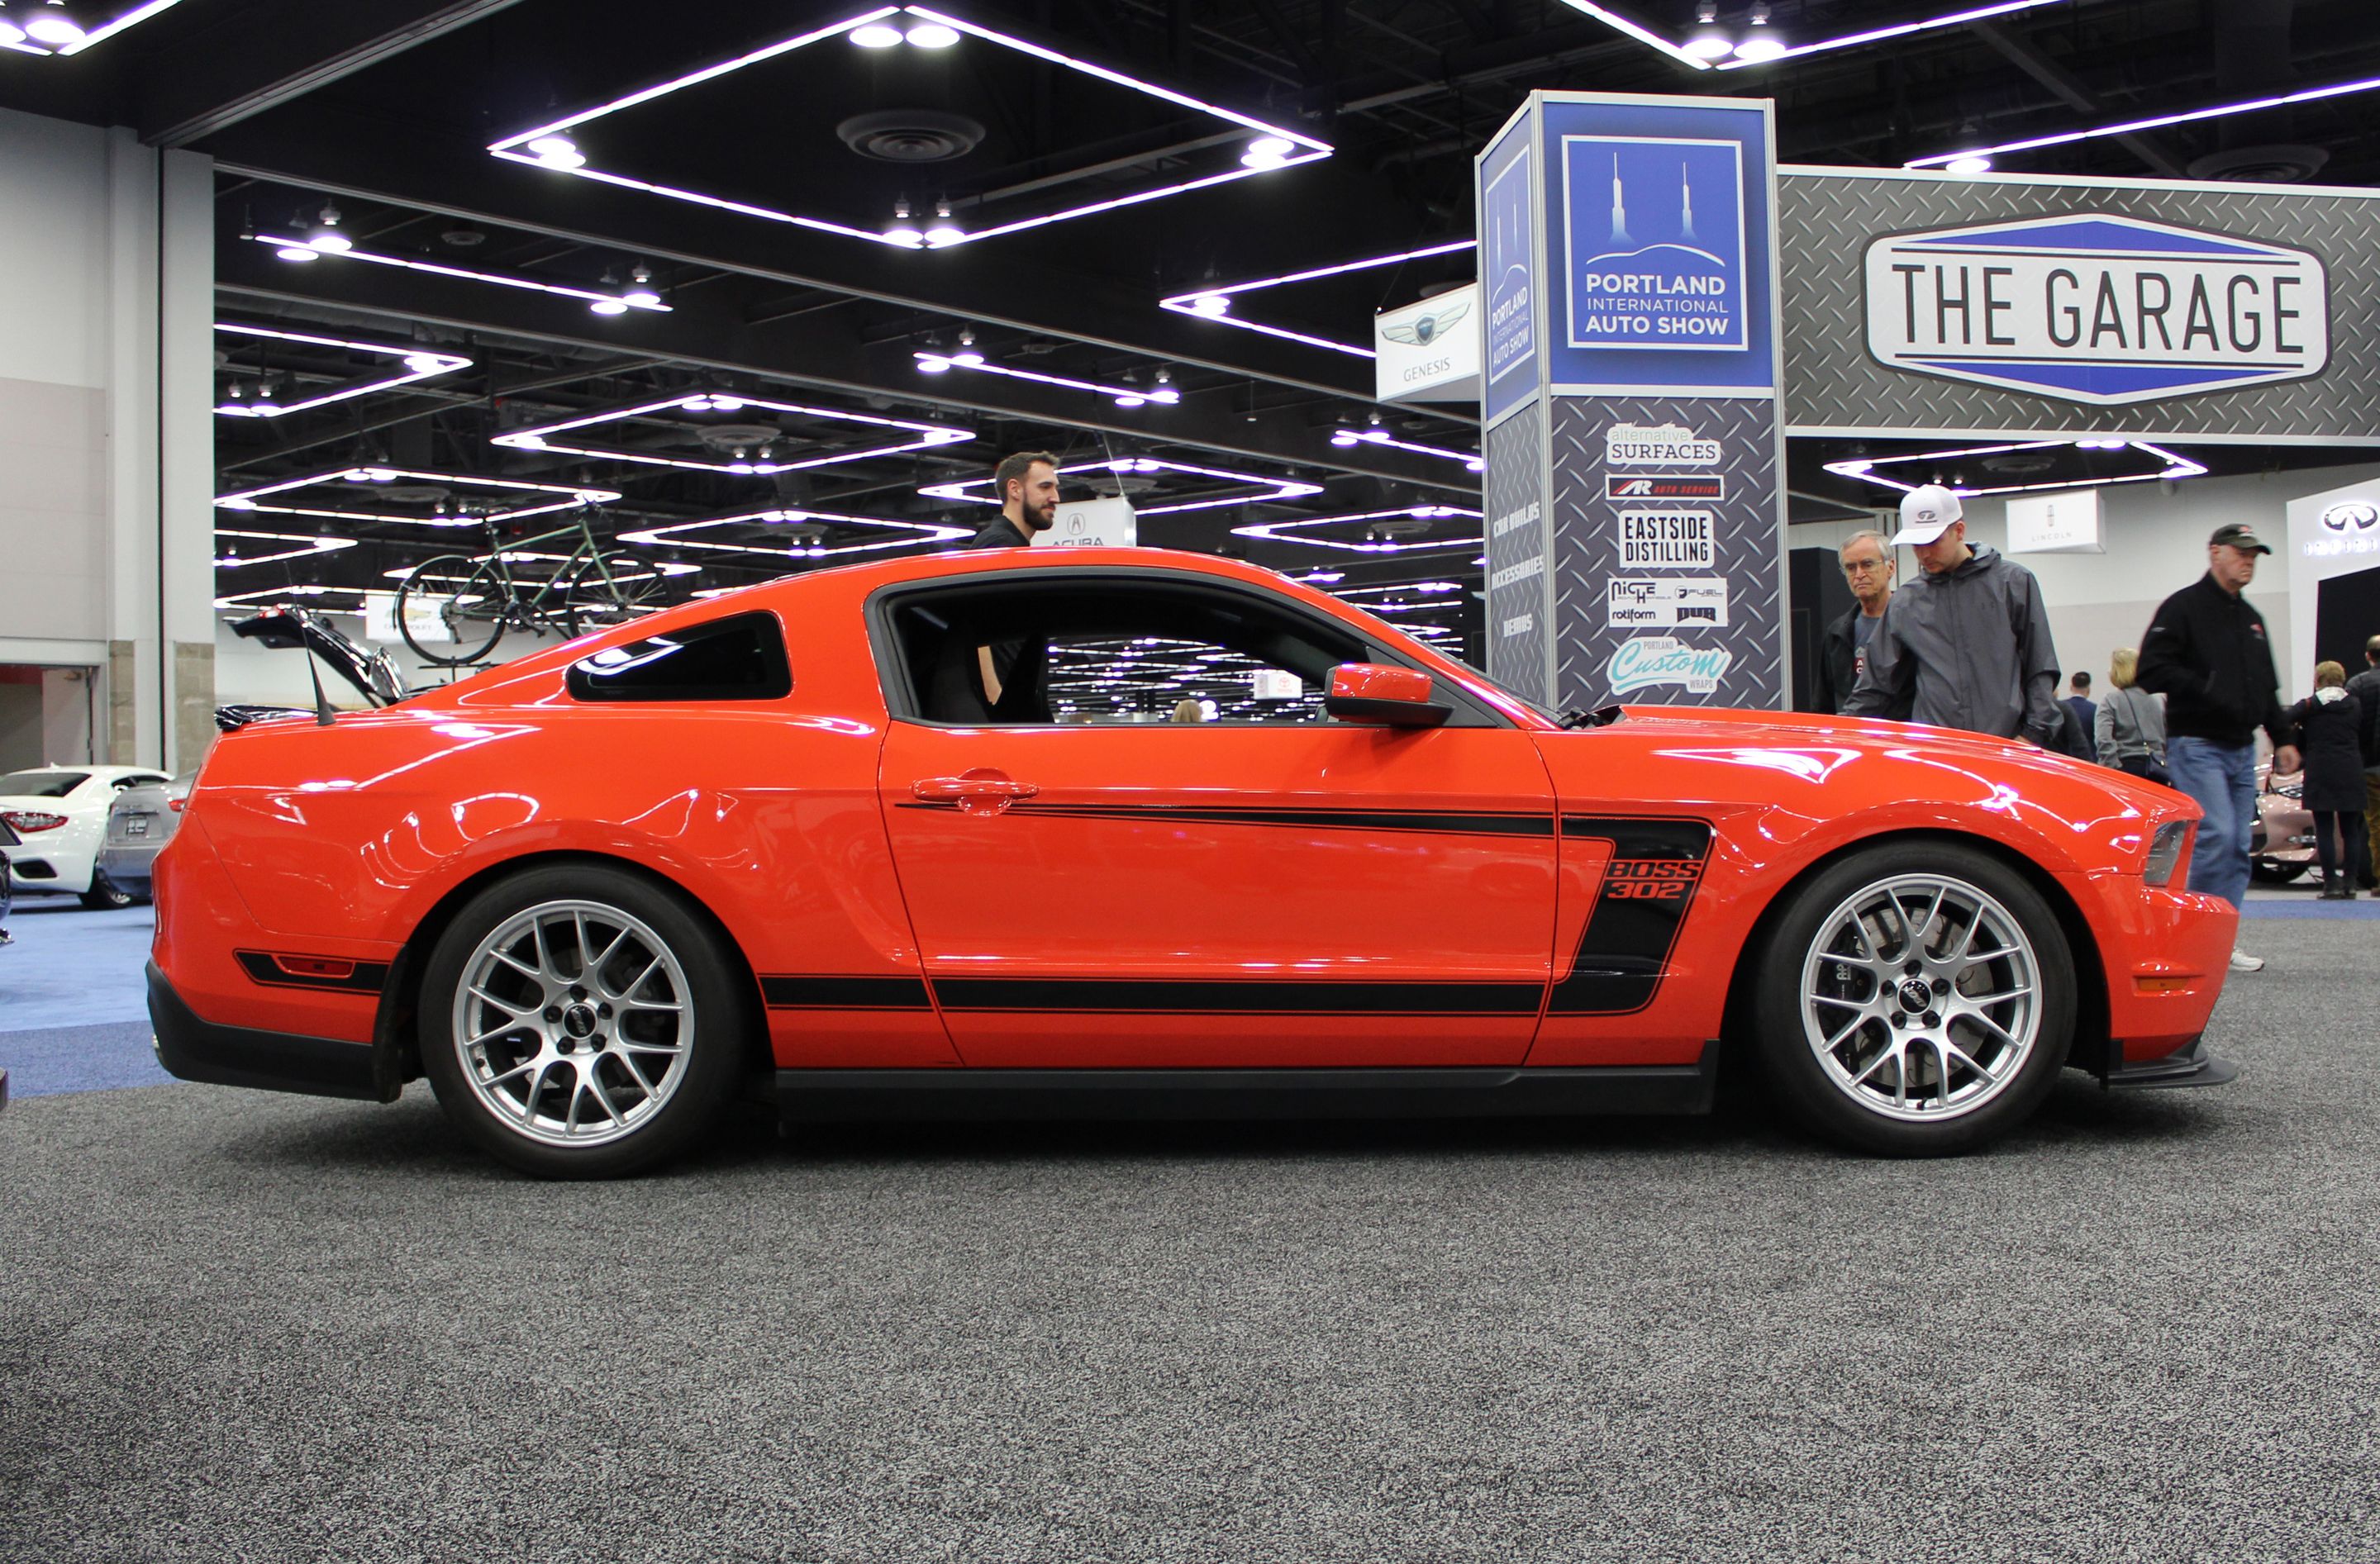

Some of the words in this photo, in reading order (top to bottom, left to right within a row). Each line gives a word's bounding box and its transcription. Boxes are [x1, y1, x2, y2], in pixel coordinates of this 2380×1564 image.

[1586, 273, 1726, 295] PORTLAND
[1492, 287, 1527, 330] PORTLAND
[1587, 297, 1729, 313] INTERNATIONAL
[1892, 264, 2016, 346] THE
[2045, 268, 2304, 354] GARAGE
[1585, 316, 1650, 334] AUTO
[1658, 317, 1729, 335] SHOW
[1493, 342, 1509, 368] AUTO
[1510, 325, 1529, 354] SHOW
[1403, 357, 1450, 382] GENESIS
[1612, 428, 1688, 442] alternative
[1612, 444, 1716, 459] SURFACES
[1493, 516, 1508, 538] CAR
[1509, 501, 1540, 531] BUILDS
[1625, 516, 1707, 540] EASTSIDE
[2031, 532, 2072, 542] LINCOLN
[1626, 542, 1708, 561] DISTILLING
[1492, 554, 1544, 590] ACCESSORIES
[1612, 609, 1656, 623] rotiform
[1676, 607, 1716, 623] DUB
[1503, 613, 1532, 638] DEMOS
[1643, 641, 1674, 650] PORTLAND
[1689, 679, 1713, 689] WRAPS
[1606, 862, 1702, 877] BOSS
[1607, 882, 1685, 899] 302
